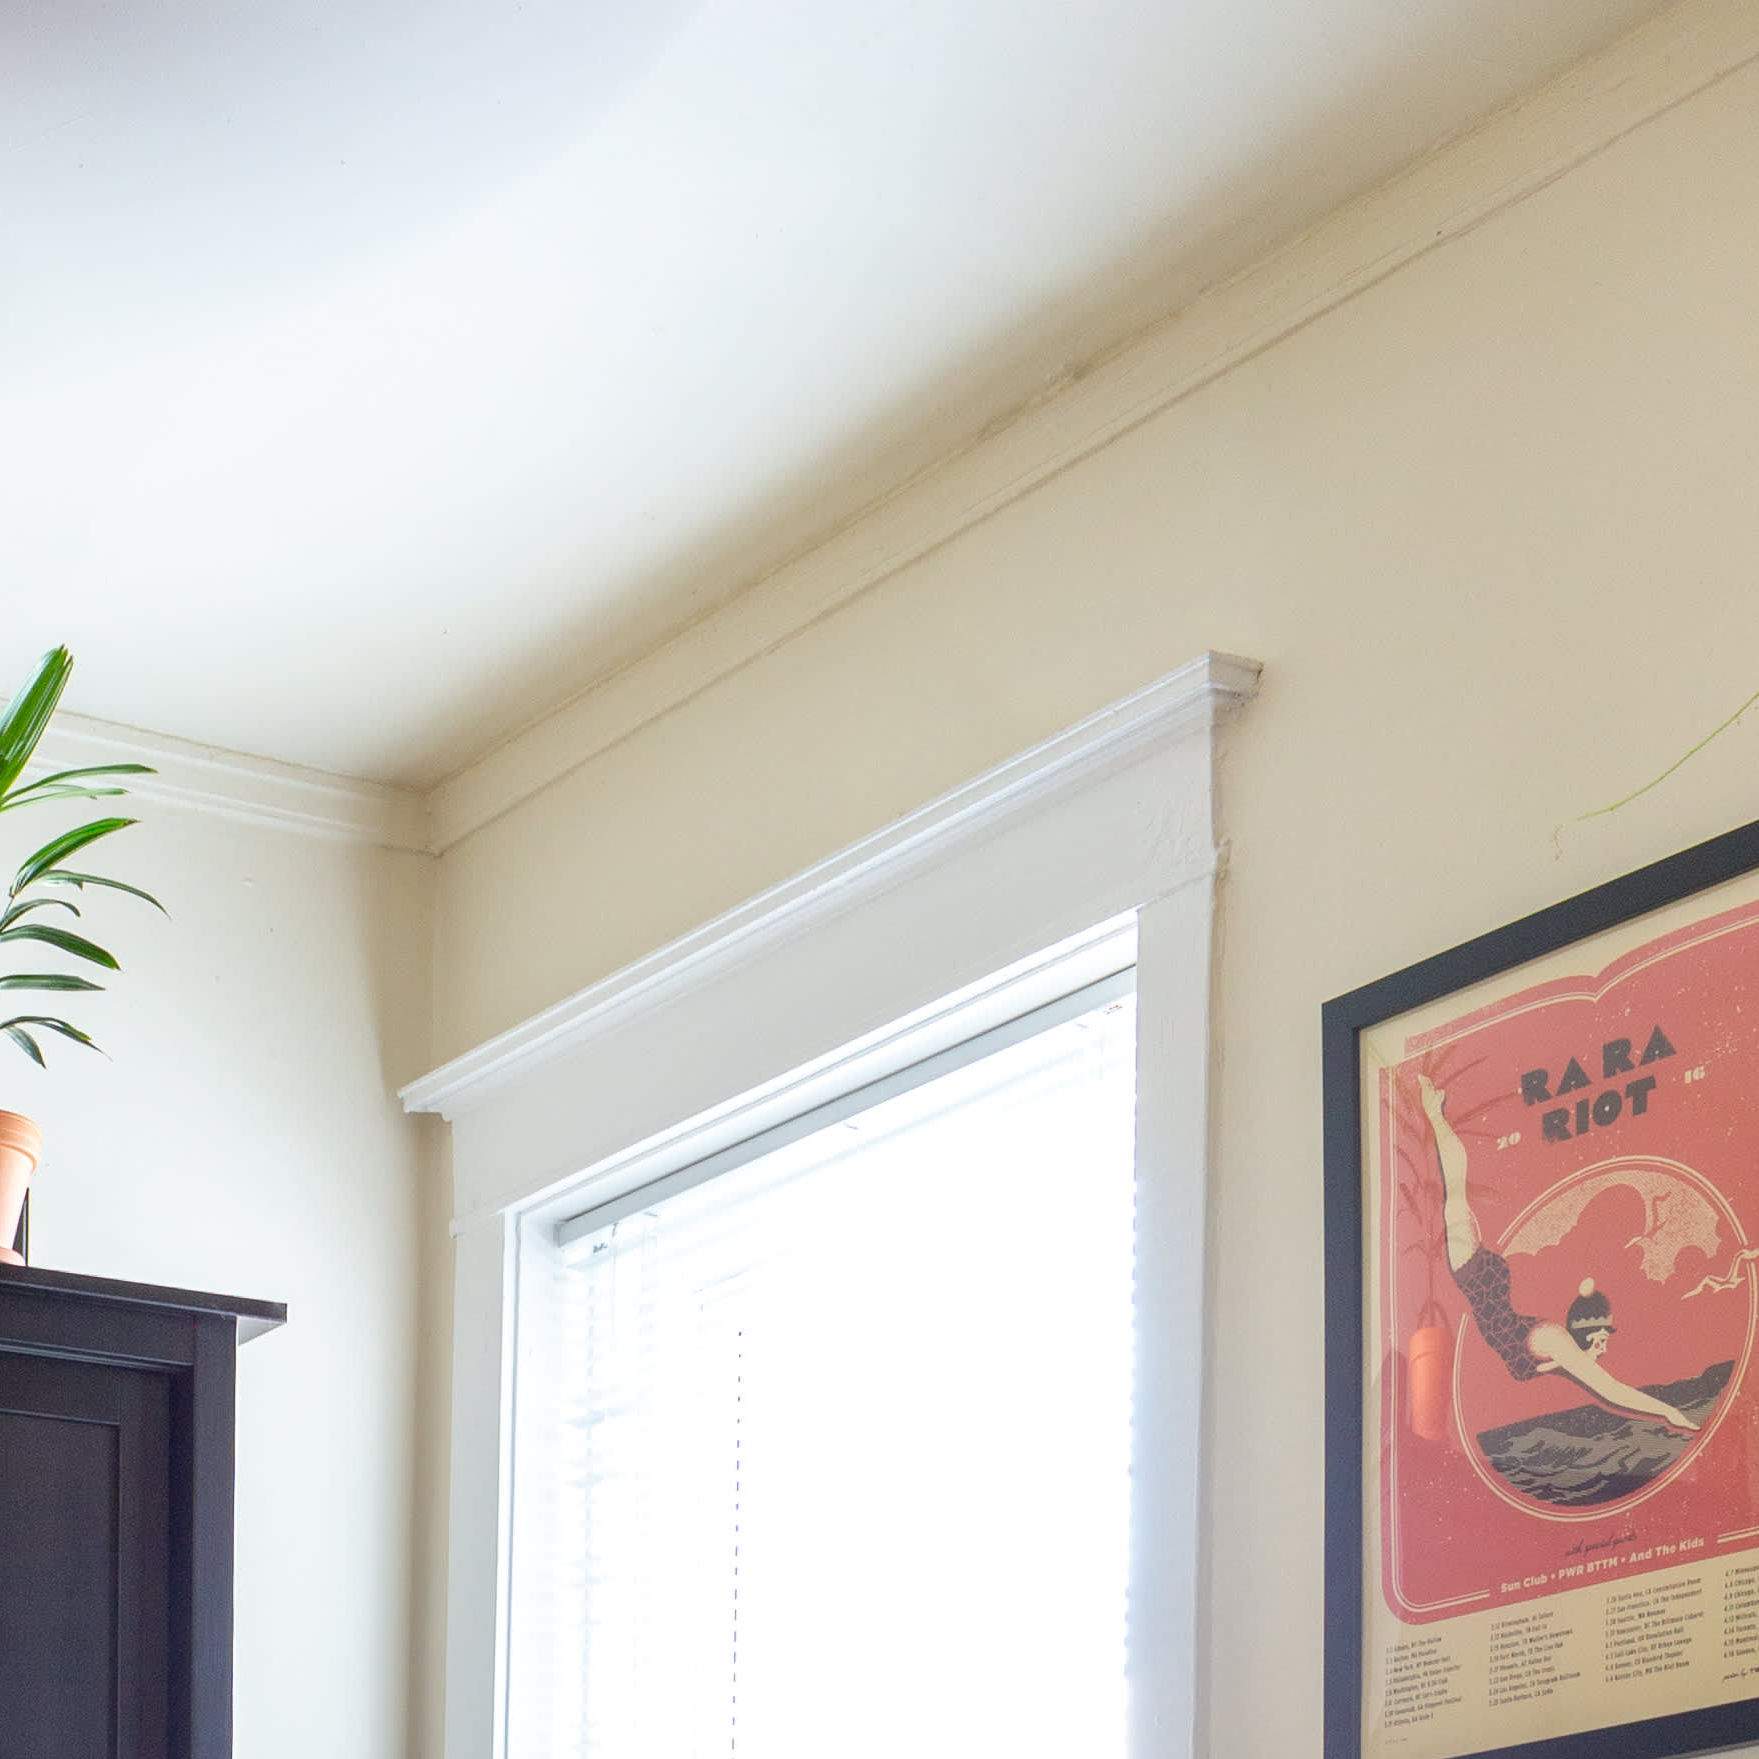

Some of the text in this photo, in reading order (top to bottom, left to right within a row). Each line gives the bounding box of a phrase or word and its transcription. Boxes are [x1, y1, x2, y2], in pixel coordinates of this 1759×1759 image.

[1521, 1024, 1677, 1106] RA RA
[1684, 1066, 1705, 1084] 16
[1542, 1075, 1656, 1144] RIOT
[1497, 1132, 1521, 1150] 20
[1500, 1536, 1705, 1593] Sun Club PWR BTTM And The Kids
